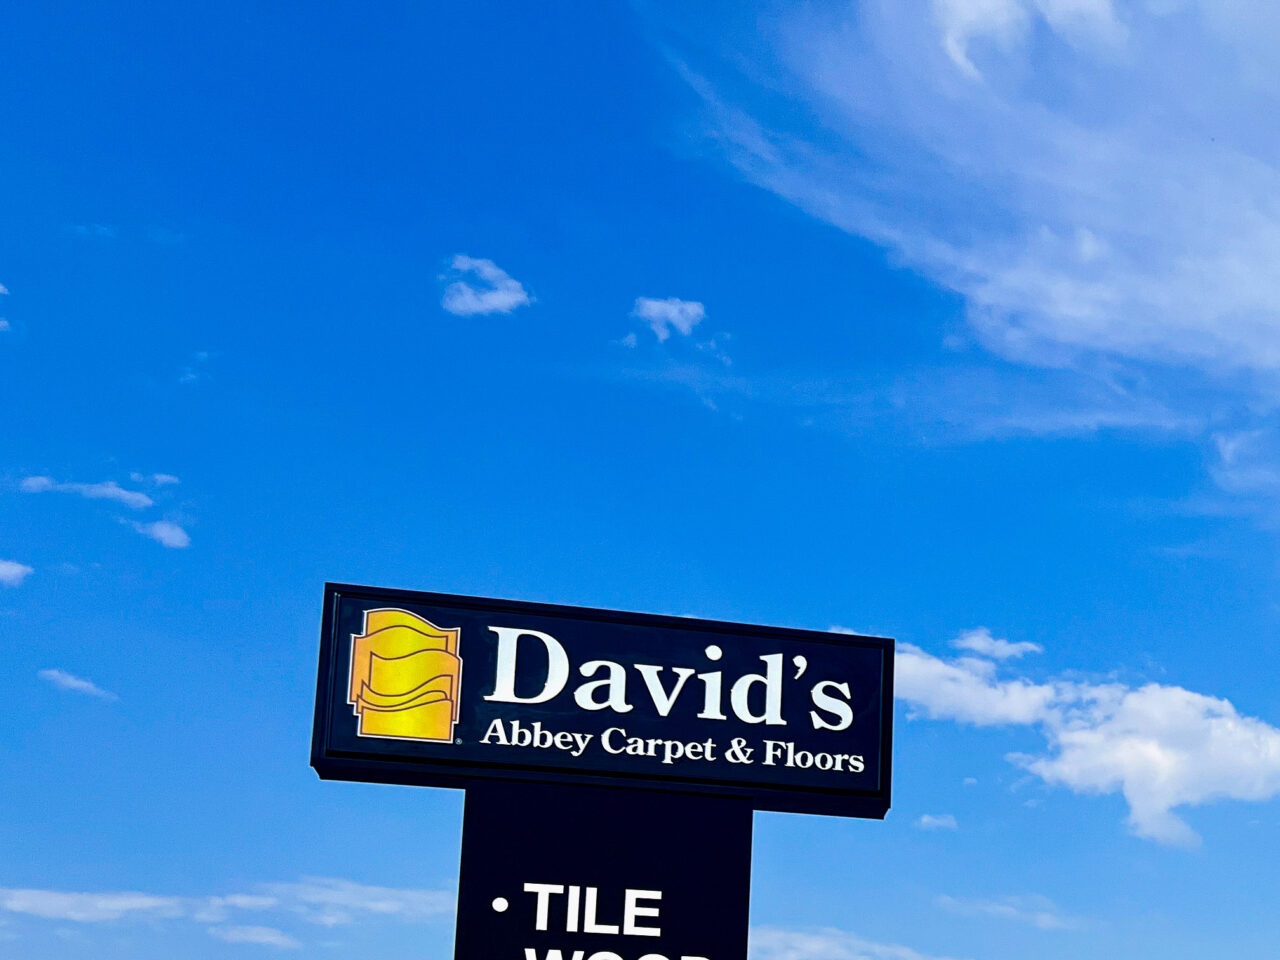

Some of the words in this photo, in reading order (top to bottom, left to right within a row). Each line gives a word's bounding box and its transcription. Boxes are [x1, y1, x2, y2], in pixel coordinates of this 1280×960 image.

[482, 625, 854, 731] David's
[479, 718, 594, 757] Abbey
[600, 727, 717, 765] Carpet
[724, 737, 755, 765] &
[762, 739, 865, 773] Floors
[523, 882, 663, 937] TILE
